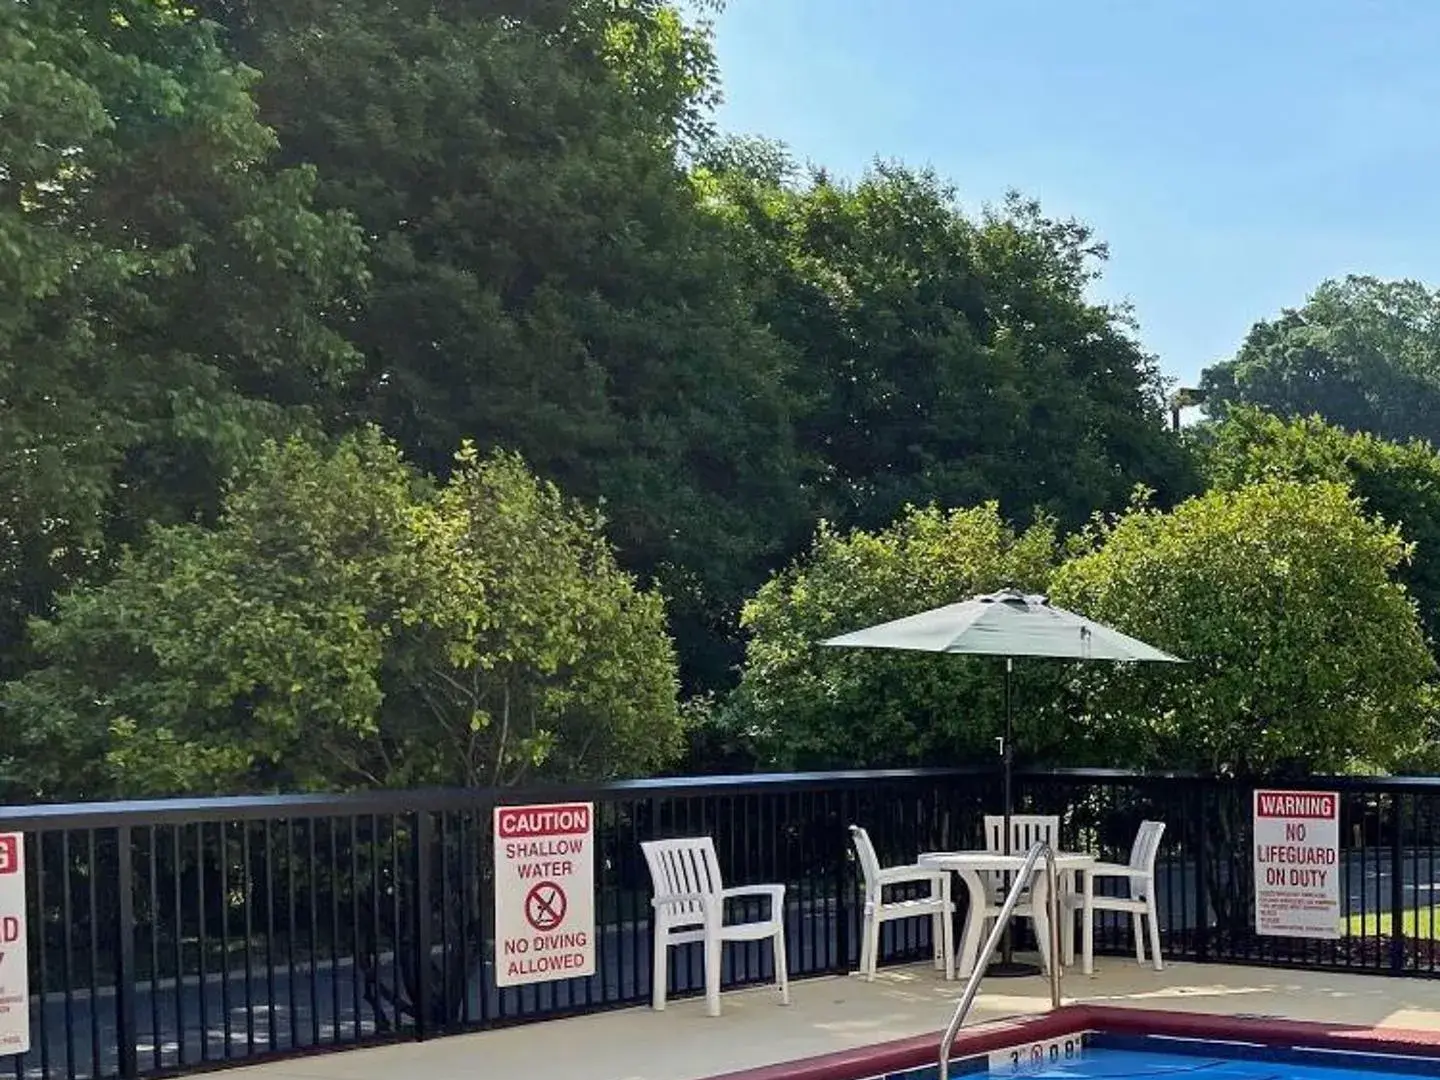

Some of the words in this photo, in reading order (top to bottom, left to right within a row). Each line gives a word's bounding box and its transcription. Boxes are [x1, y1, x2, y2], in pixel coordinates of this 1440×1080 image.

[1260, 796, 1332, 816] WARNING
[502, 811, 587, 833] CAUTION
[1286, 823, 1306, 841] NO
[506, 839, 583, 859] SHALLOW
[1257, 845, 1335, 865] LIFEGUARD
[518, 861, 573, 880] WATER
[1266, 868, 1285, 886] ON
[1290, 869, 1328, 887] DUTY
[504, 938, 529, 955] NO
[533, 932, 587, 951] DIVING
[508, 953, 585, 976] ALLOWED
